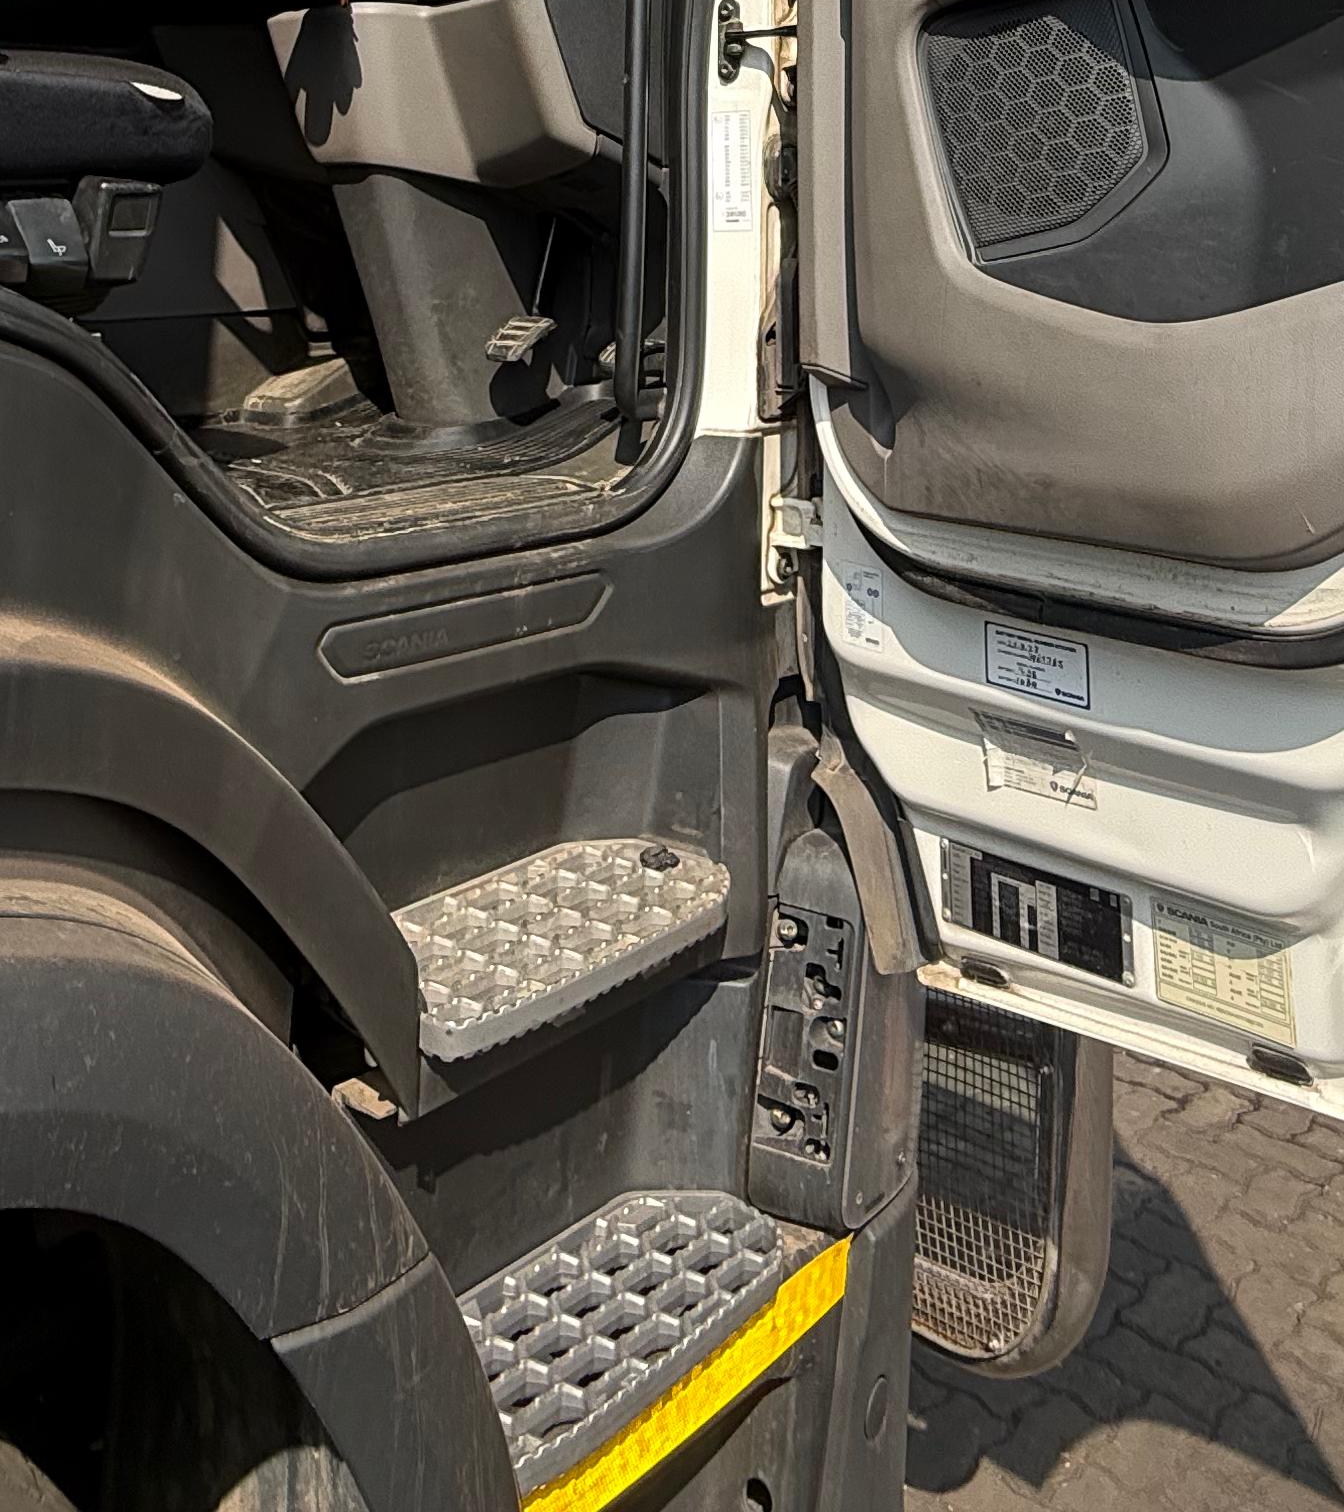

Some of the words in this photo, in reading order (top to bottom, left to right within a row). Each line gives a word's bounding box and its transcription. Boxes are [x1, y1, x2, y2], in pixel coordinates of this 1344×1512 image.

[361, 630, 449, 662] SCANIA
[1167, 907, 1208, 926] SCANIA
[1210, 921, 1229, 932] South
[1231, 928, 1251, 940] Africa
